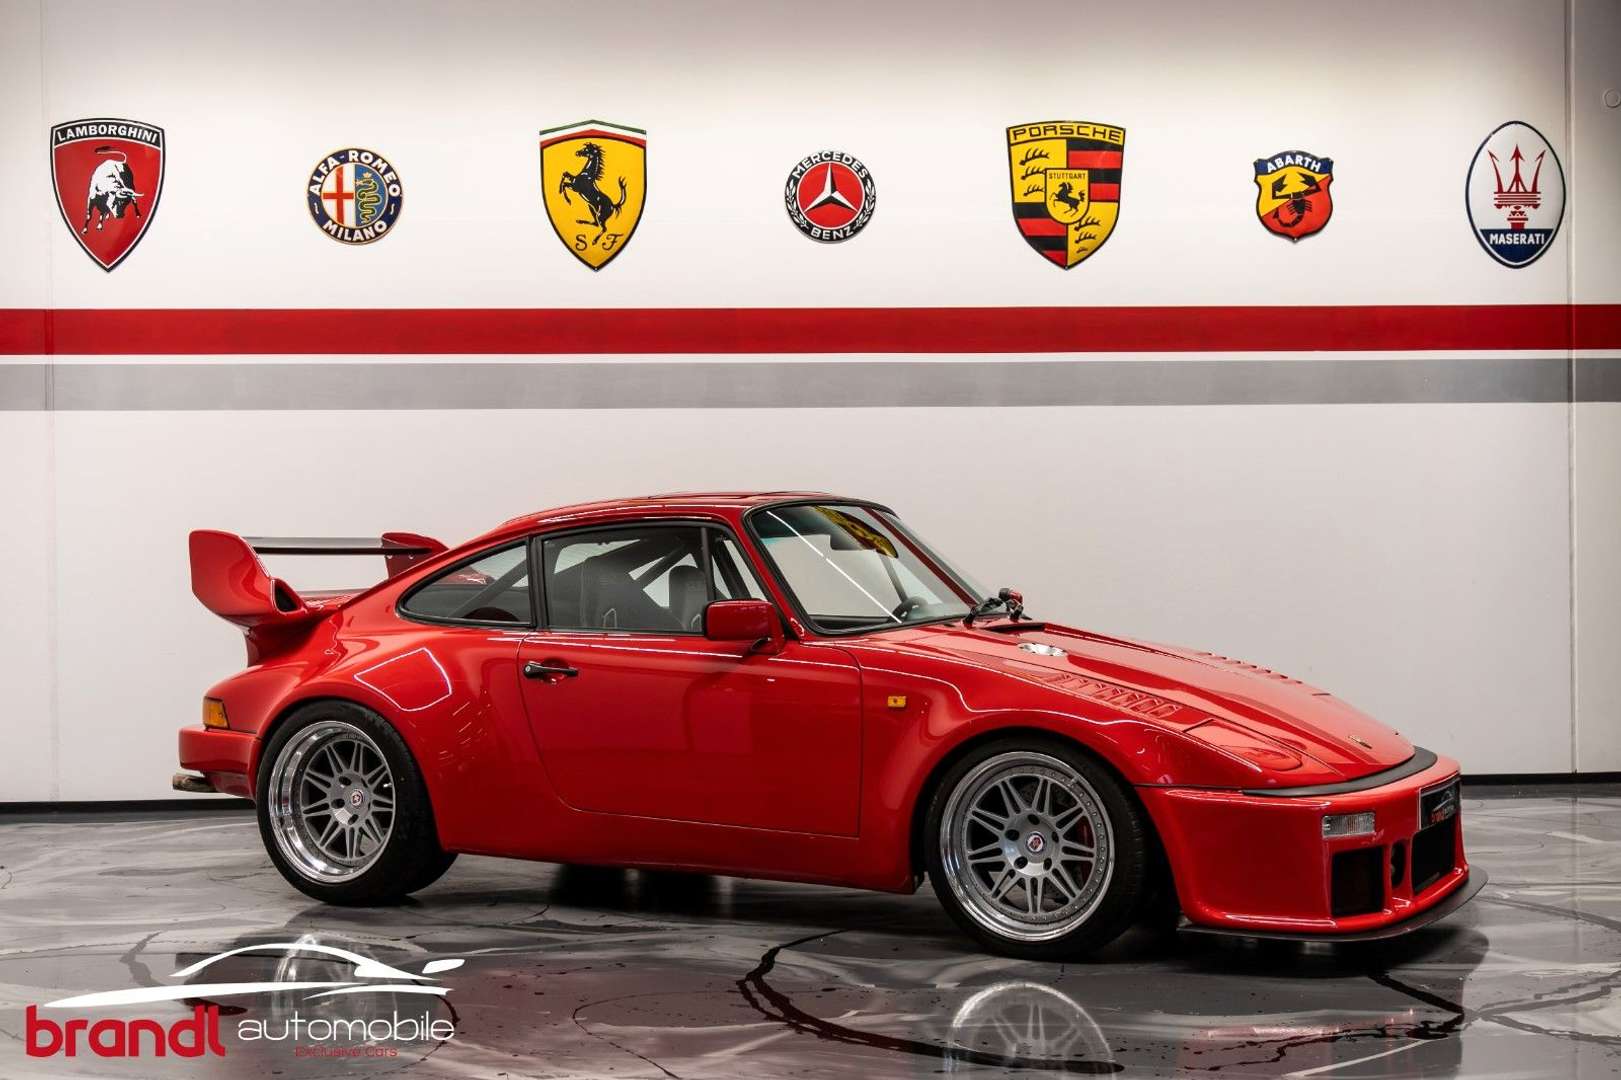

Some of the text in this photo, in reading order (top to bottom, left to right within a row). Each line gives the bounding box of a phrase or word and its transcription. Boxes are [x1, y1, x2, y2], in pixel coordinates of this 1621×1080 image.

[57, 124, 158, 143] LAMBORGHINI
[1012, 125, 1121, 142] PORSCHE
[792, 151, 868, 178] MERCEDES
[1267, 155, 1321, 172] ABARTH
[1048, 172, 1086, 180] STUTTGART
[323, 220, 387, 241] MILANO
[810, 227, 854, 240] BENZ
[1489, 233, 1545, 245] MASERATI
[575, 233, 623, 251] S F
